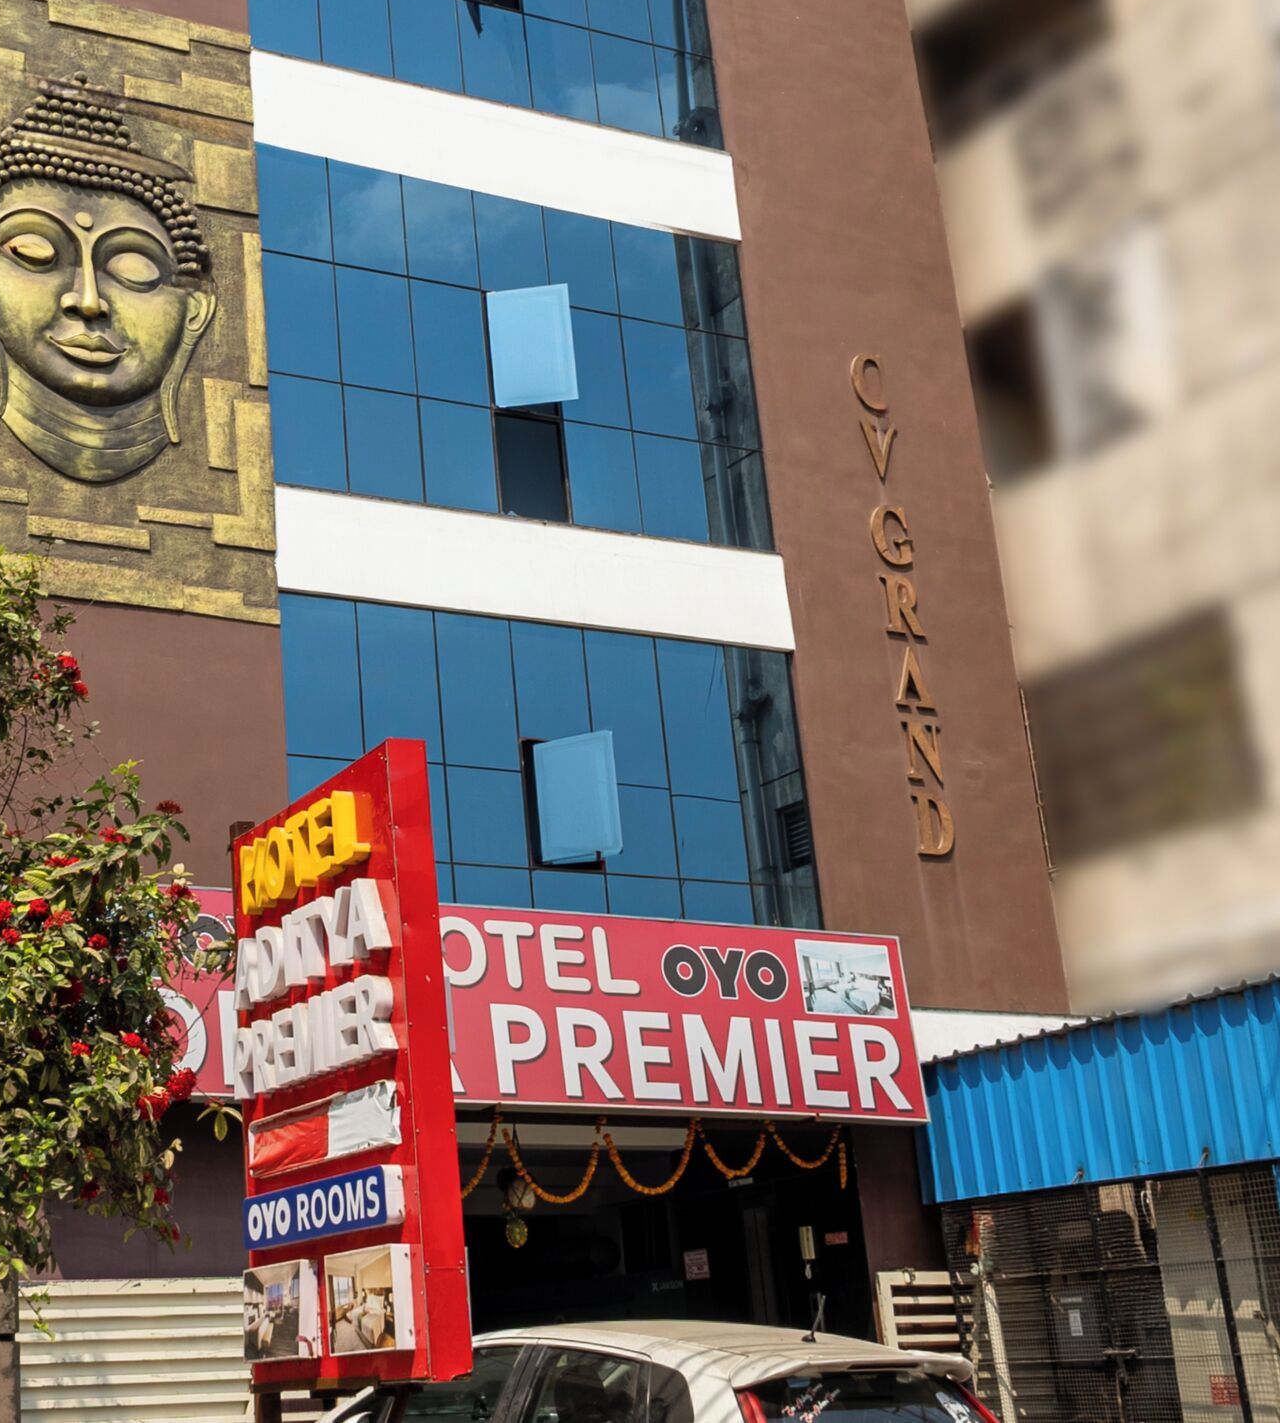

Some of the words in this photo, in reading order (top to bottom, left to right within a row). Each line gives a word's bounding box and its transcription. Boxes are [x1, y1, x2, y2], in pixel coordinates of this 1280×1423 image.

[869, 504, 956, 857] GRAND
[239, 790, 370, 915] HOTEL
[234, 877, 392, 1011] ADITYA
[439, 916, 641, 996] OTEL
[661, 943, 790, 1003] OYO
[234, 974, 399, 1100] PREMIER
[489, 1003, 913, 1110] PREMIER
[248, 1197, 291, 1241] OYO
[296, 1176, 380, 1231] ROOMS
